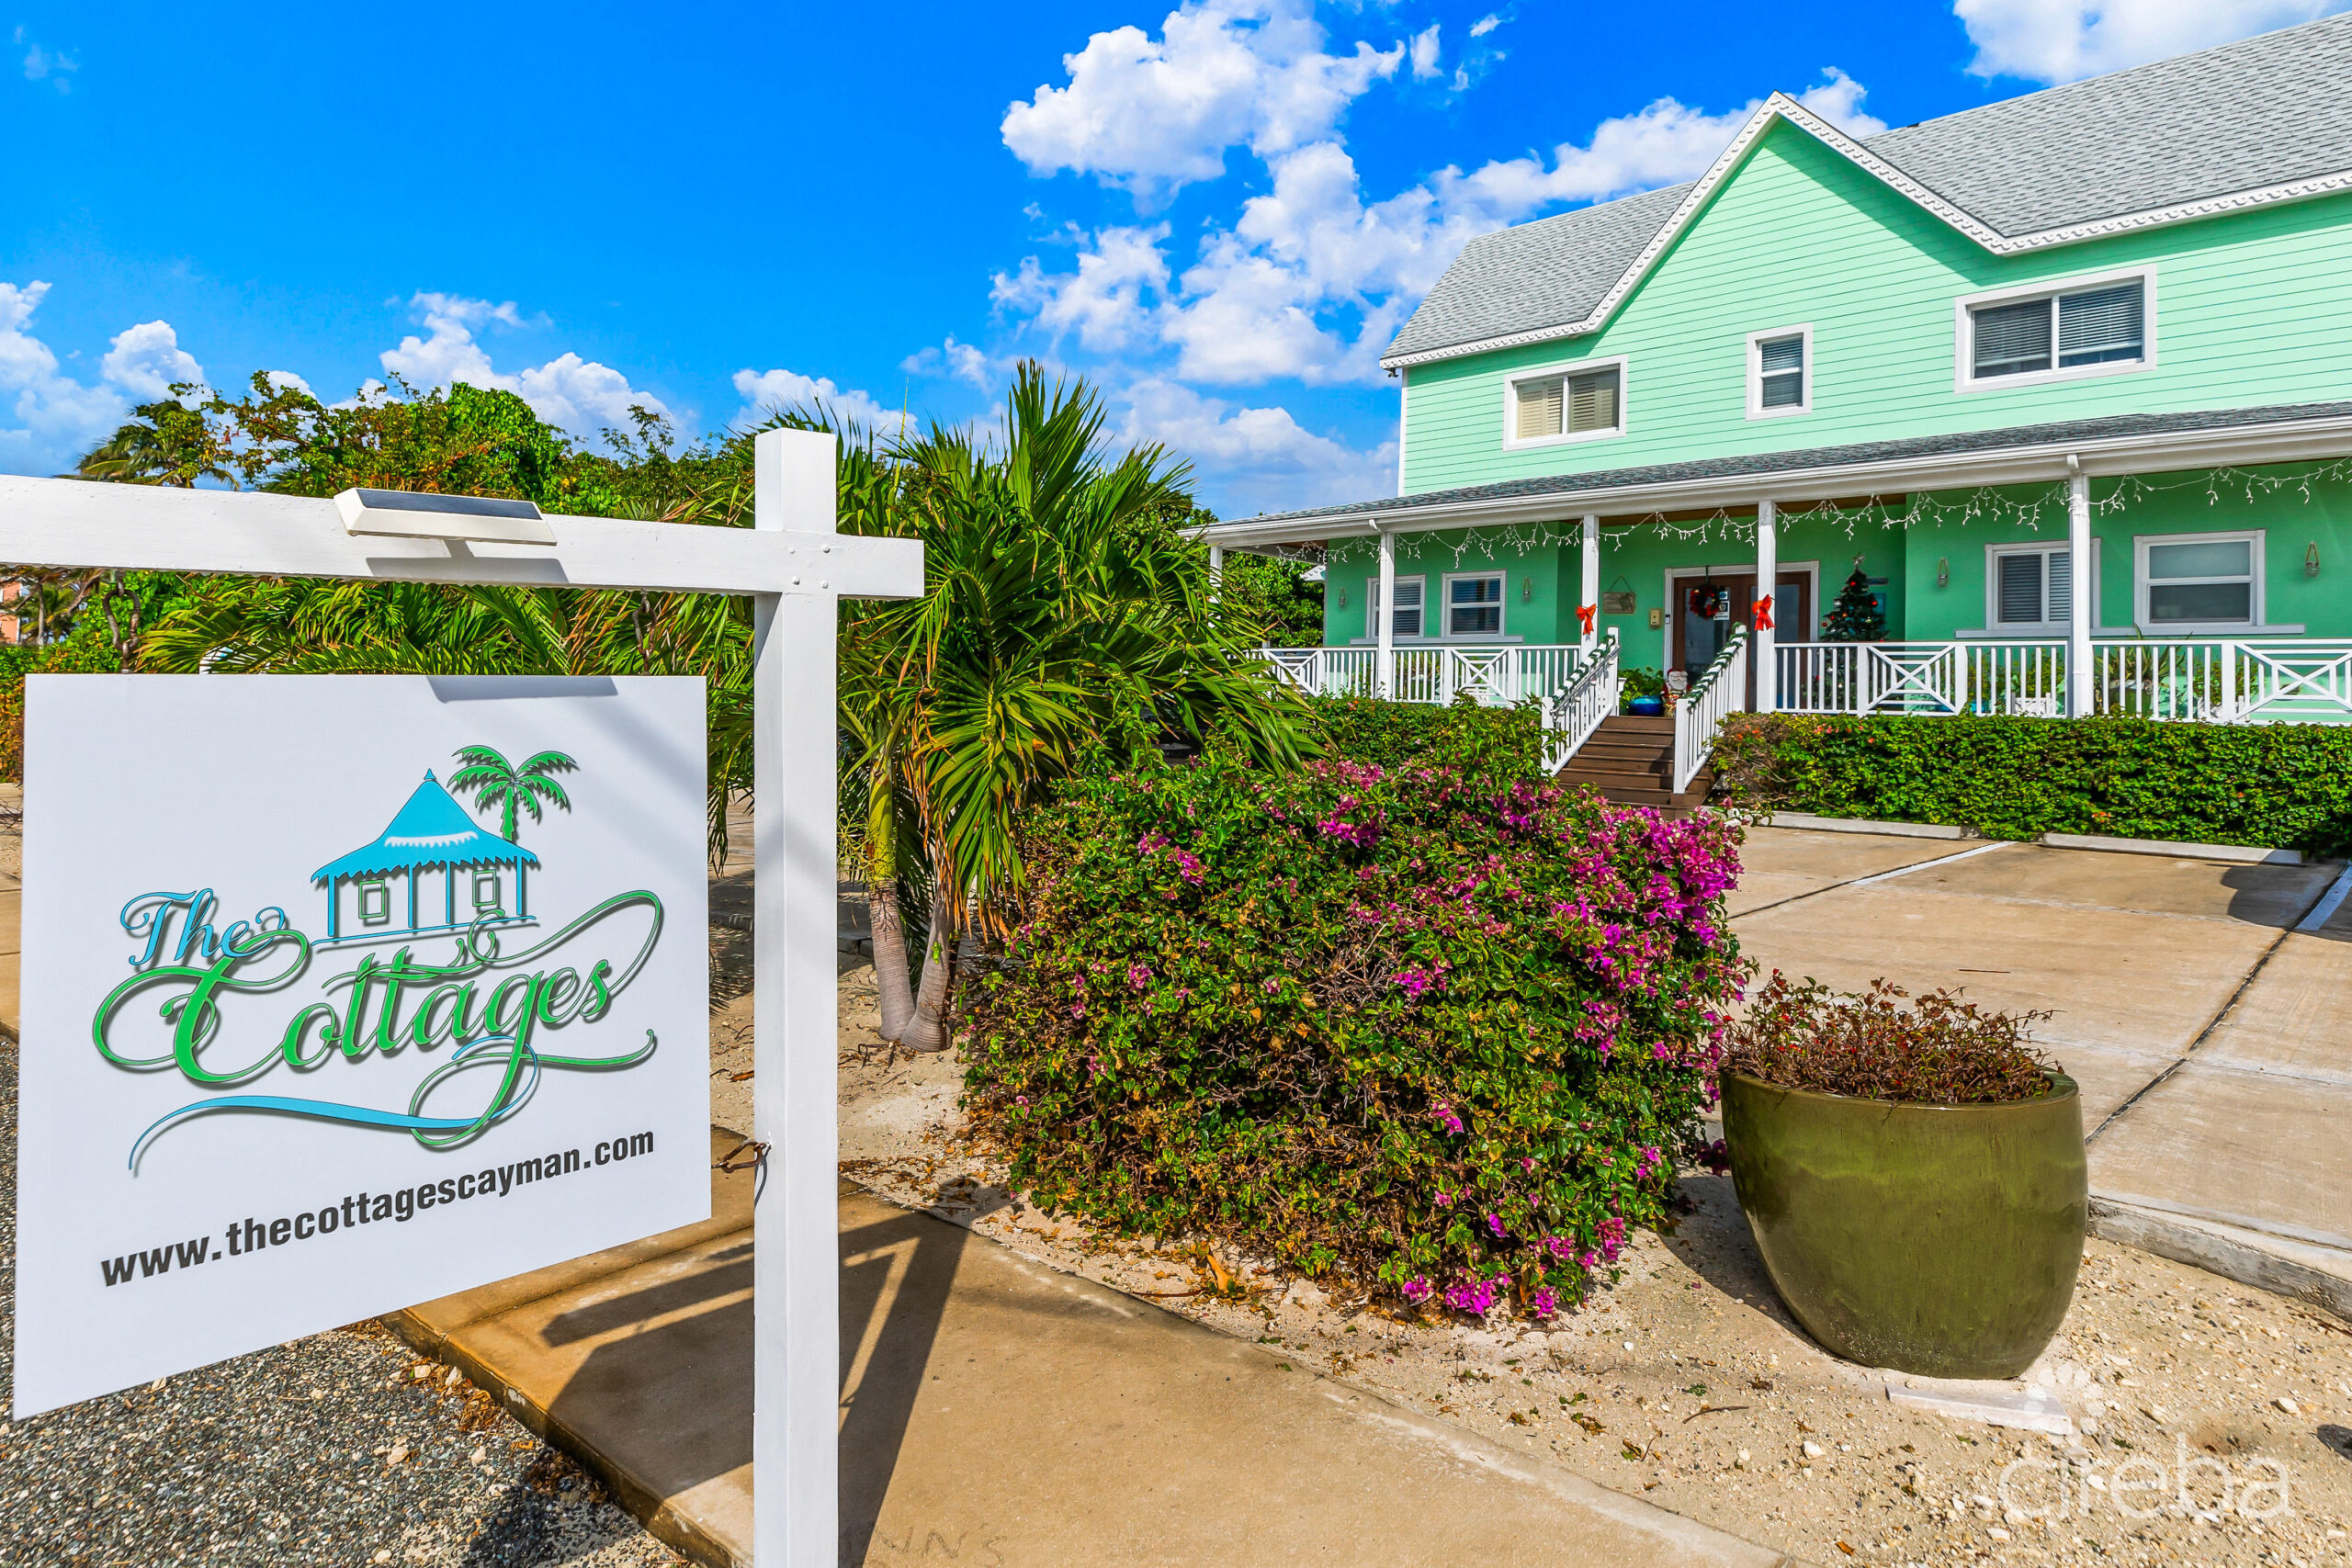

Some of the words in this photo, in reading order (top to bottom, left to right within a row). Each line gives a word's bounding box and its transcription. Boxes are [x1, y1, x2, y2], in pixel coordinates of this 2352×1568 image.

[120, 887, 286, 965] The
[92, 890, 662, 1145] Cottages
[100, 1130, 655, 1287] www.thecottagescayman.com
